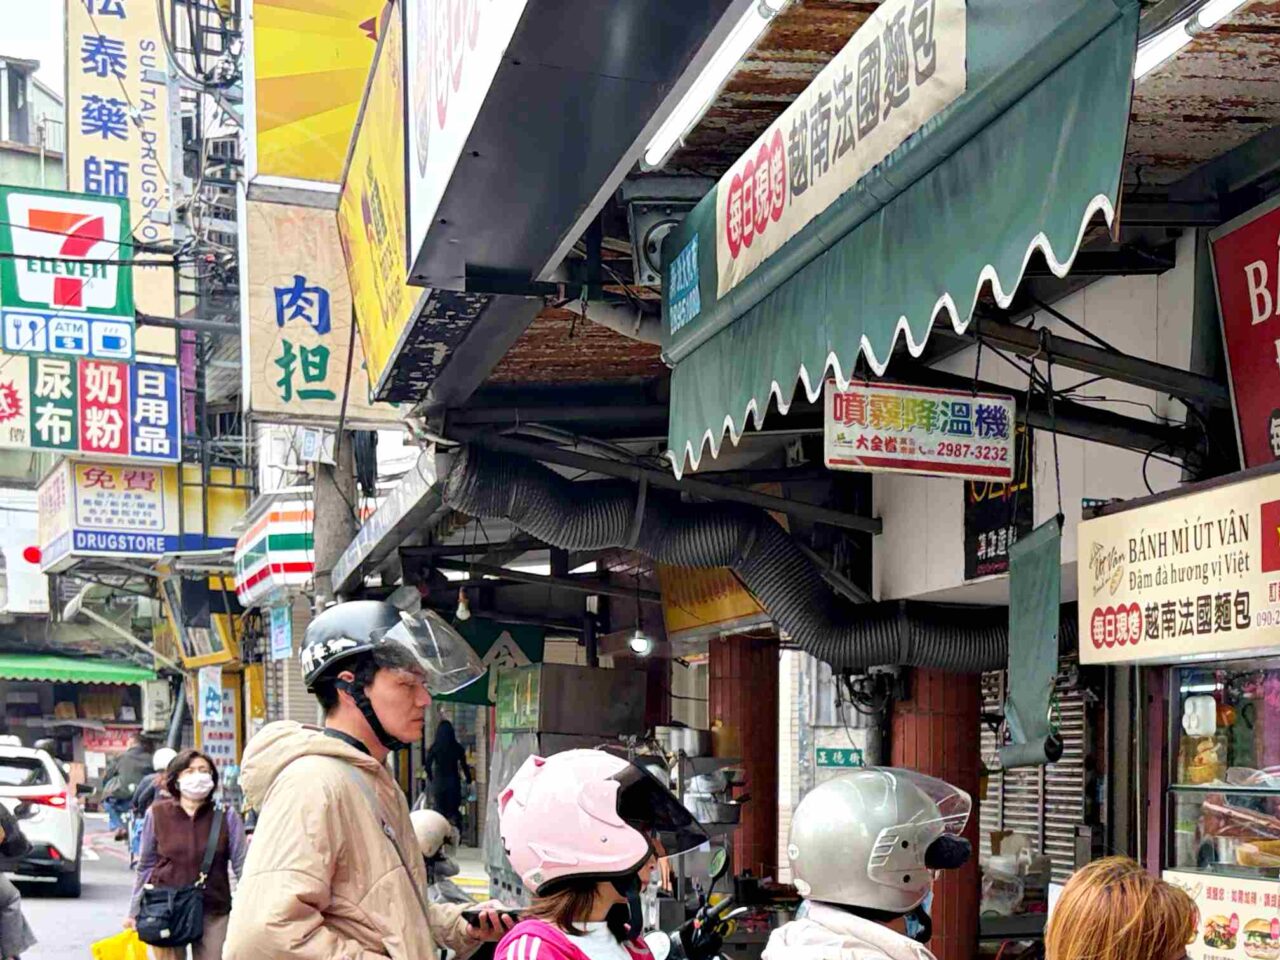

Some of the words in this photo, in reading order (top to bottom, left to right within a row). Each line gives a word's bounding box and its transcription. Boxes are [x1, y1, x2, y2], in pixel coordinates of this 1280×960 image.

[787, 0, 937, 205] 越南法國麵包
[54, 322, 84, 333] ATM
[34, 358, 73, 446] 尿布
[85, 363, 123, 449] 奶粉
[134, 370, 171, 456] 日用品
[833, 392, 1009, 439] 噴霧降溫機
[937, 442, 1008, 461] 2987-3232
[83, 467, 156, 492] 免費
[76, 532, 166, 552] DRUGSTORE
[1128, 526, 1168, 564] BÁNH
[1171, 516, 1192, 554] MÌ
[1194, 516, 1213, 550] ÚT
[1217, 509, 1250, 545] VÂN
[1129, 568, 1154, 595] Đậm
[1155, 563, 1168, 587] đà
[1170, 560, 1209, 585] hương
[1211, 557, 1224, 583] vị
[1225, 551, 1250, 579] Việt
[1091, 604, 1141, 649] 每日現烤
[1144, 590, 1251, 642] 越南法國麵包
